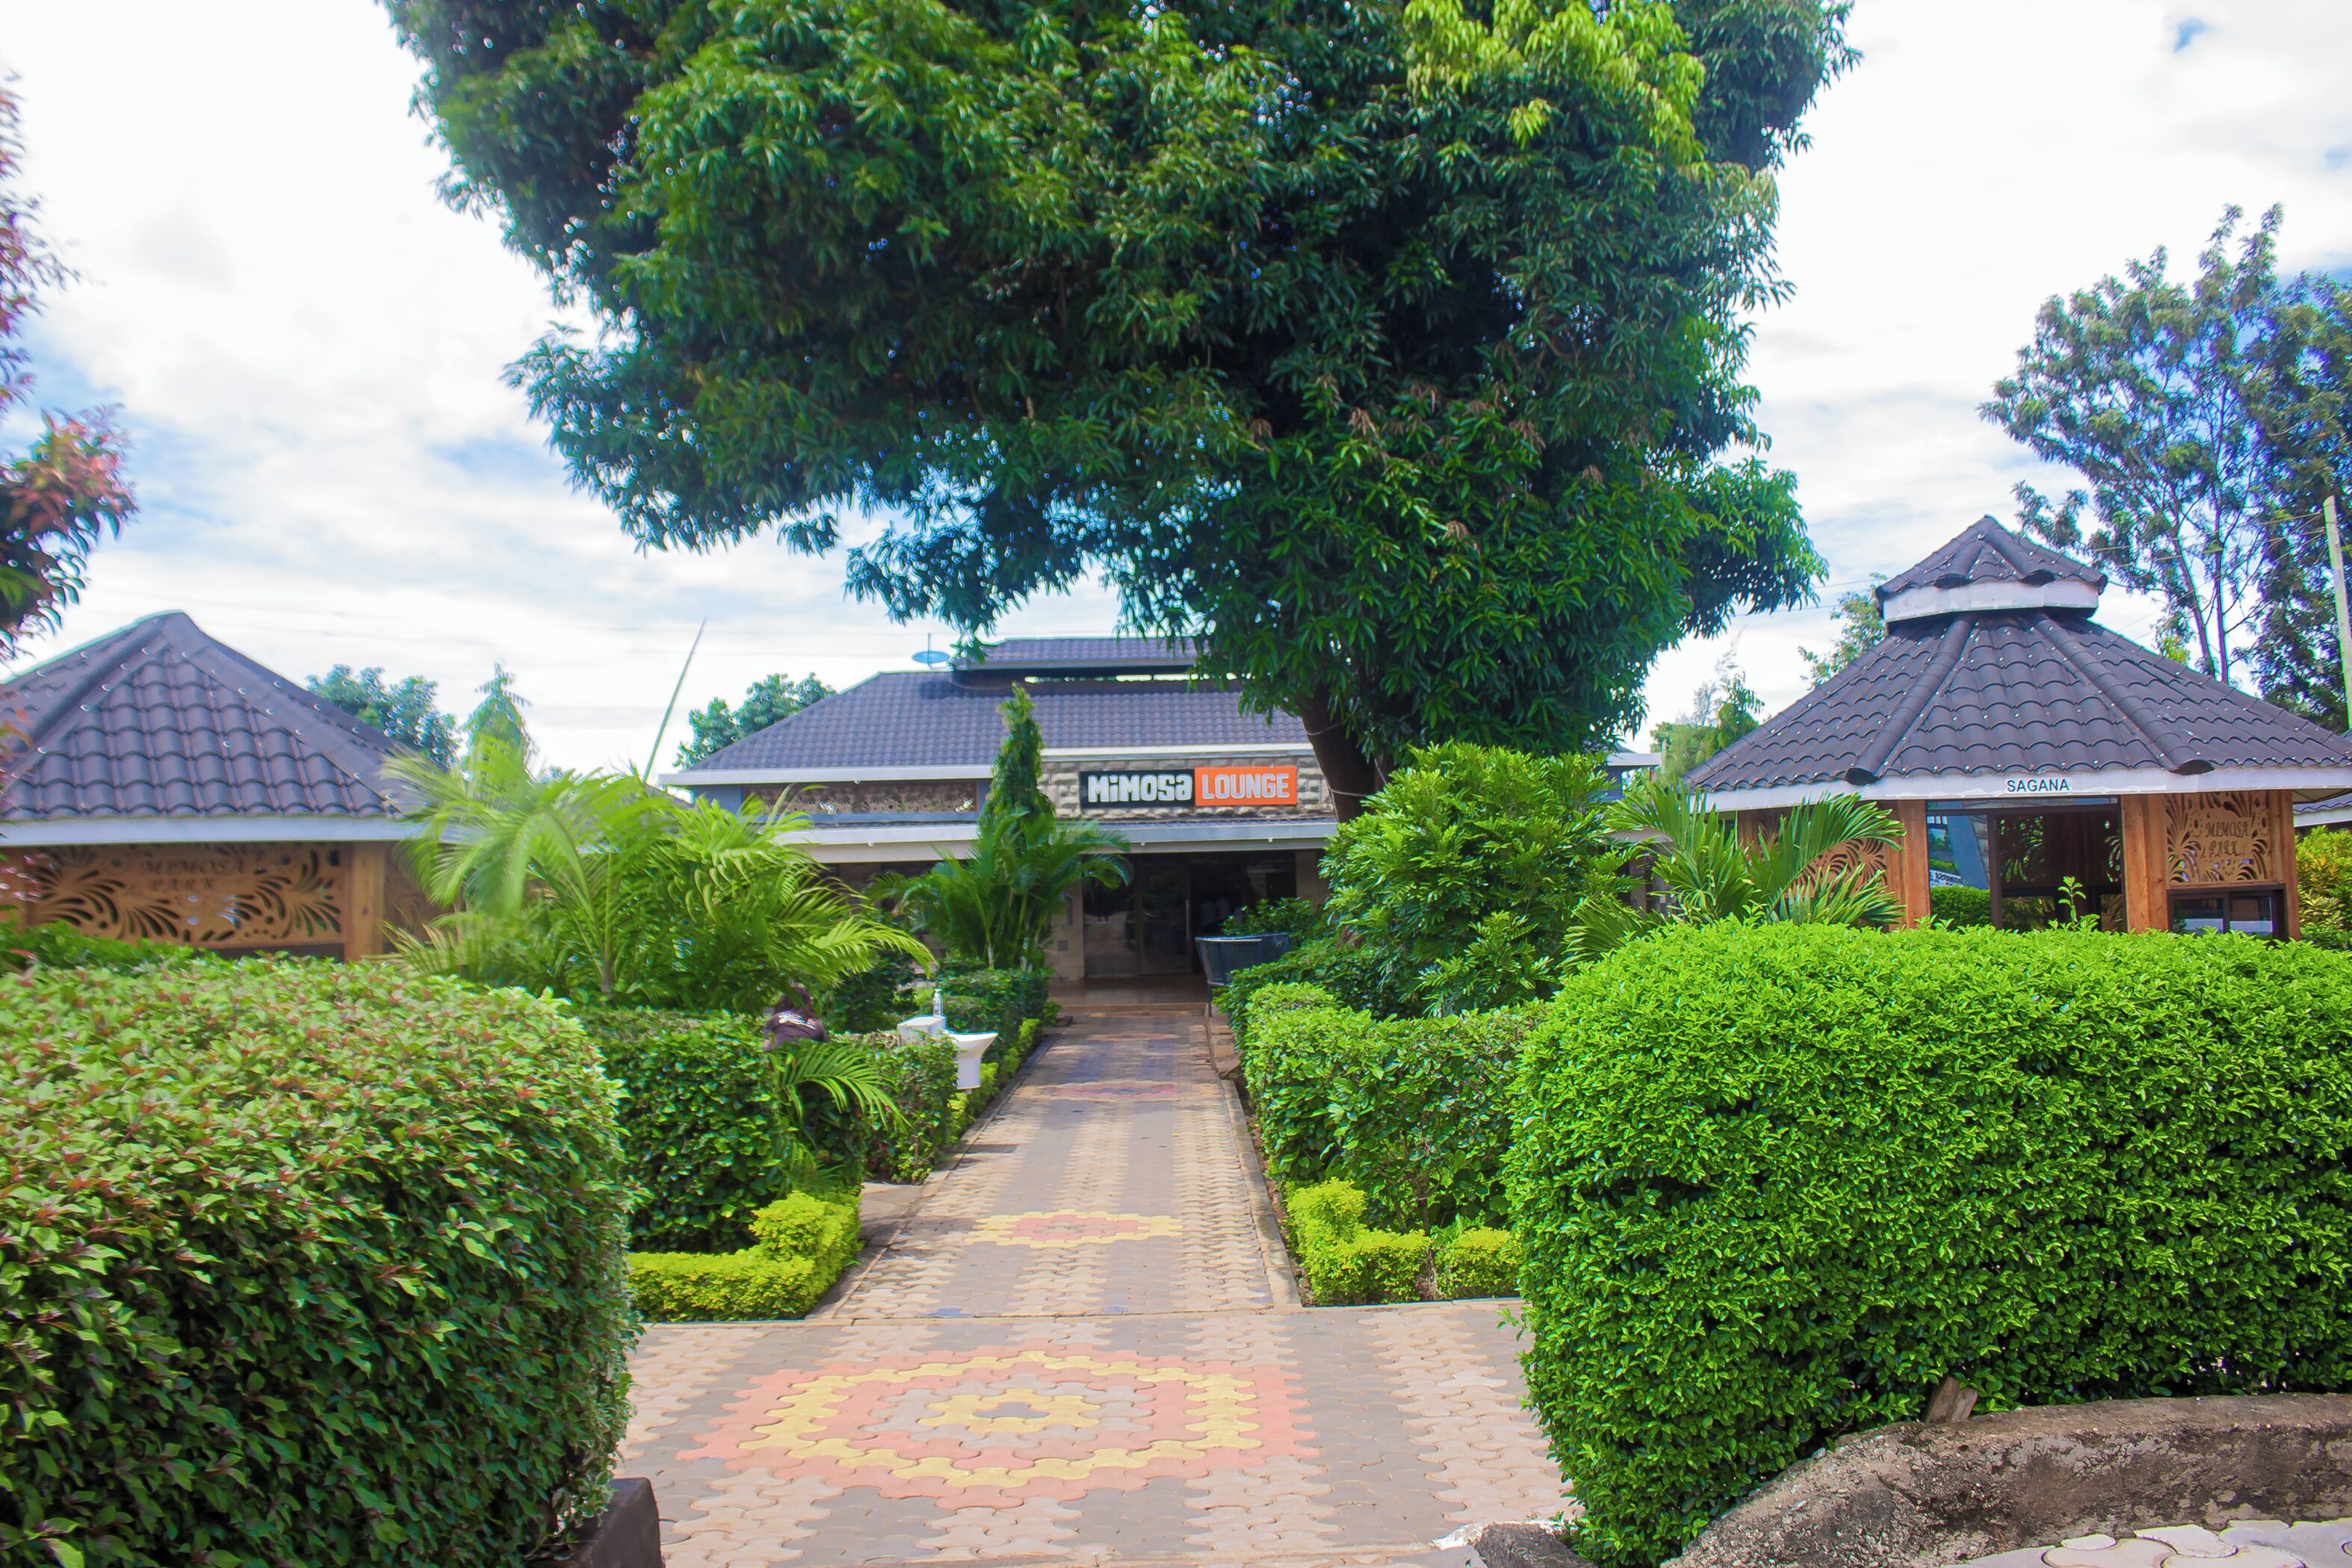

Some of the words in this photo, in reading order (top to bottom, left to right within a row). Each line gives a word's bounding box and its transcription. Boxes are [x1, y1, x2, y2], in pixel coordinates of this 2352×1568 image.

[1201, 773, 1290, 799] LOUNGE
[2007, 778, 2070, 792] SAGANA
[2206, 821, 2248, 838] MIMOSA
[2209, 840, 2241, 858] PARK
